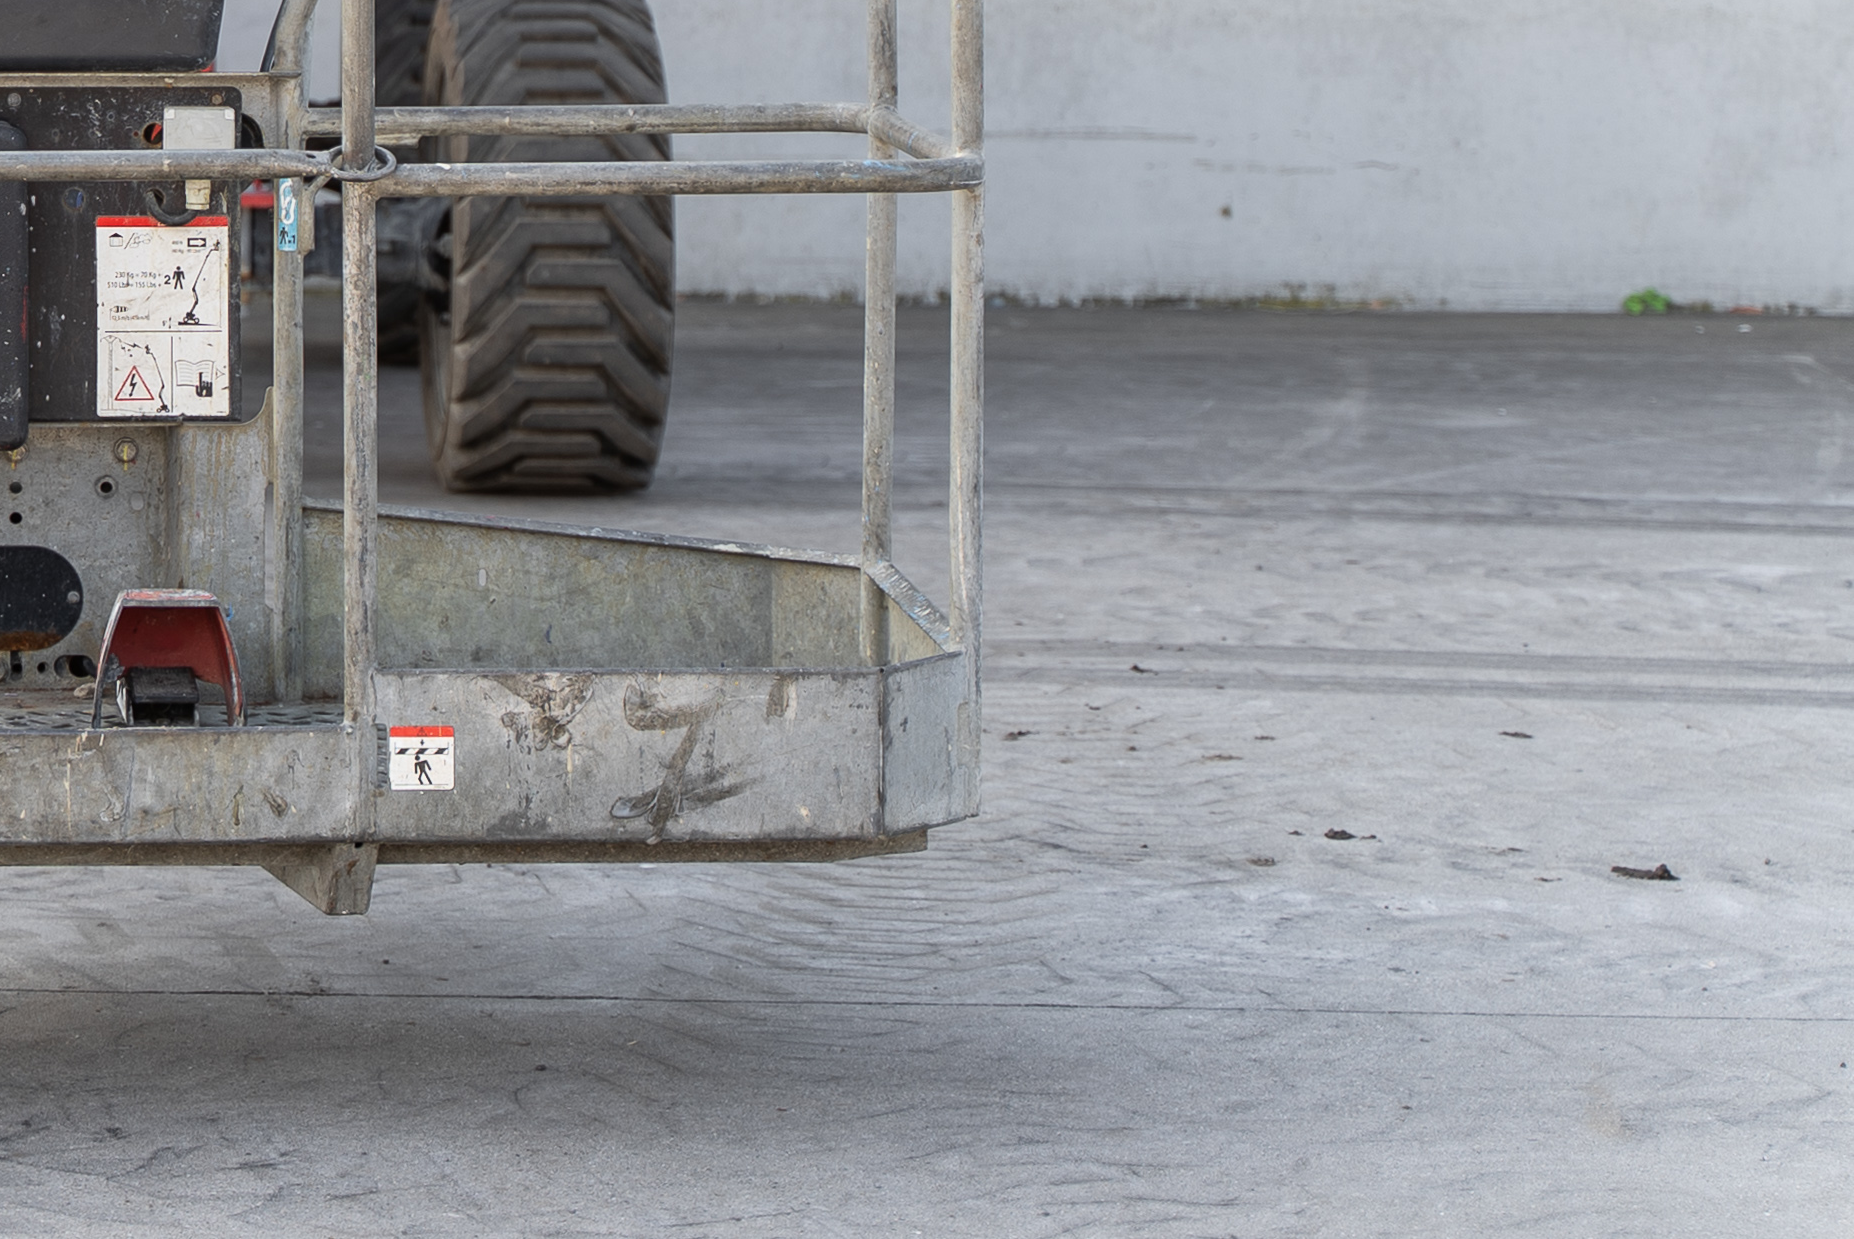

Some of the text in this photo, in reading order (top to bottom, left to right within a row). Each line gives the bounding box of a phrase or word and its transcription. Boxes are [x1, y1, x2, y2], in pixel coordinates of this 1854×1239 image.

[114, 271, 126, 279] 230
[126, 271, 135, 280] Kg
[148, 271, 157, 280] Kg
[164, 274, 171, 285] 2
[107, 281, 118, 289] 510
[135, 281, 146, 289] 155
